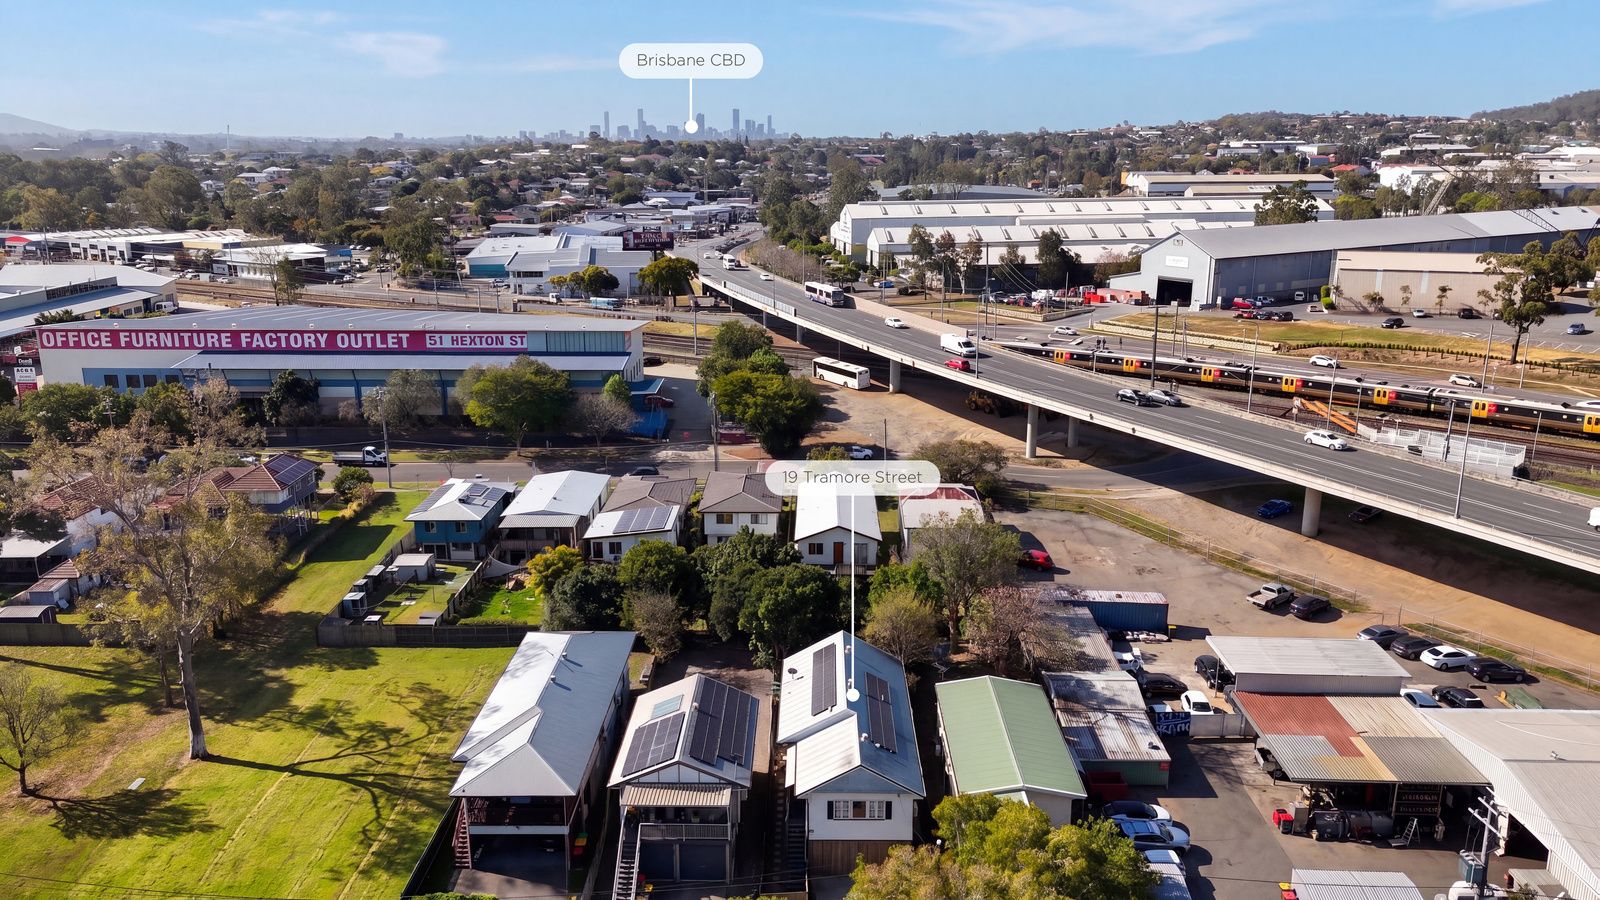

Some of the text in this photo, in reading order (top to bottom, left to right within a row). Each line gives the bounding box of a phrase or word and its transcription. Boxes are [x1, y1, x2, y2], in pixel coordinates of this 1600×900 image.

[42, 331, 410, 349] OFFICE FURNITURE FACTORY OUTLET
[428, 335, 525, 346] 51 HEXTON ST
